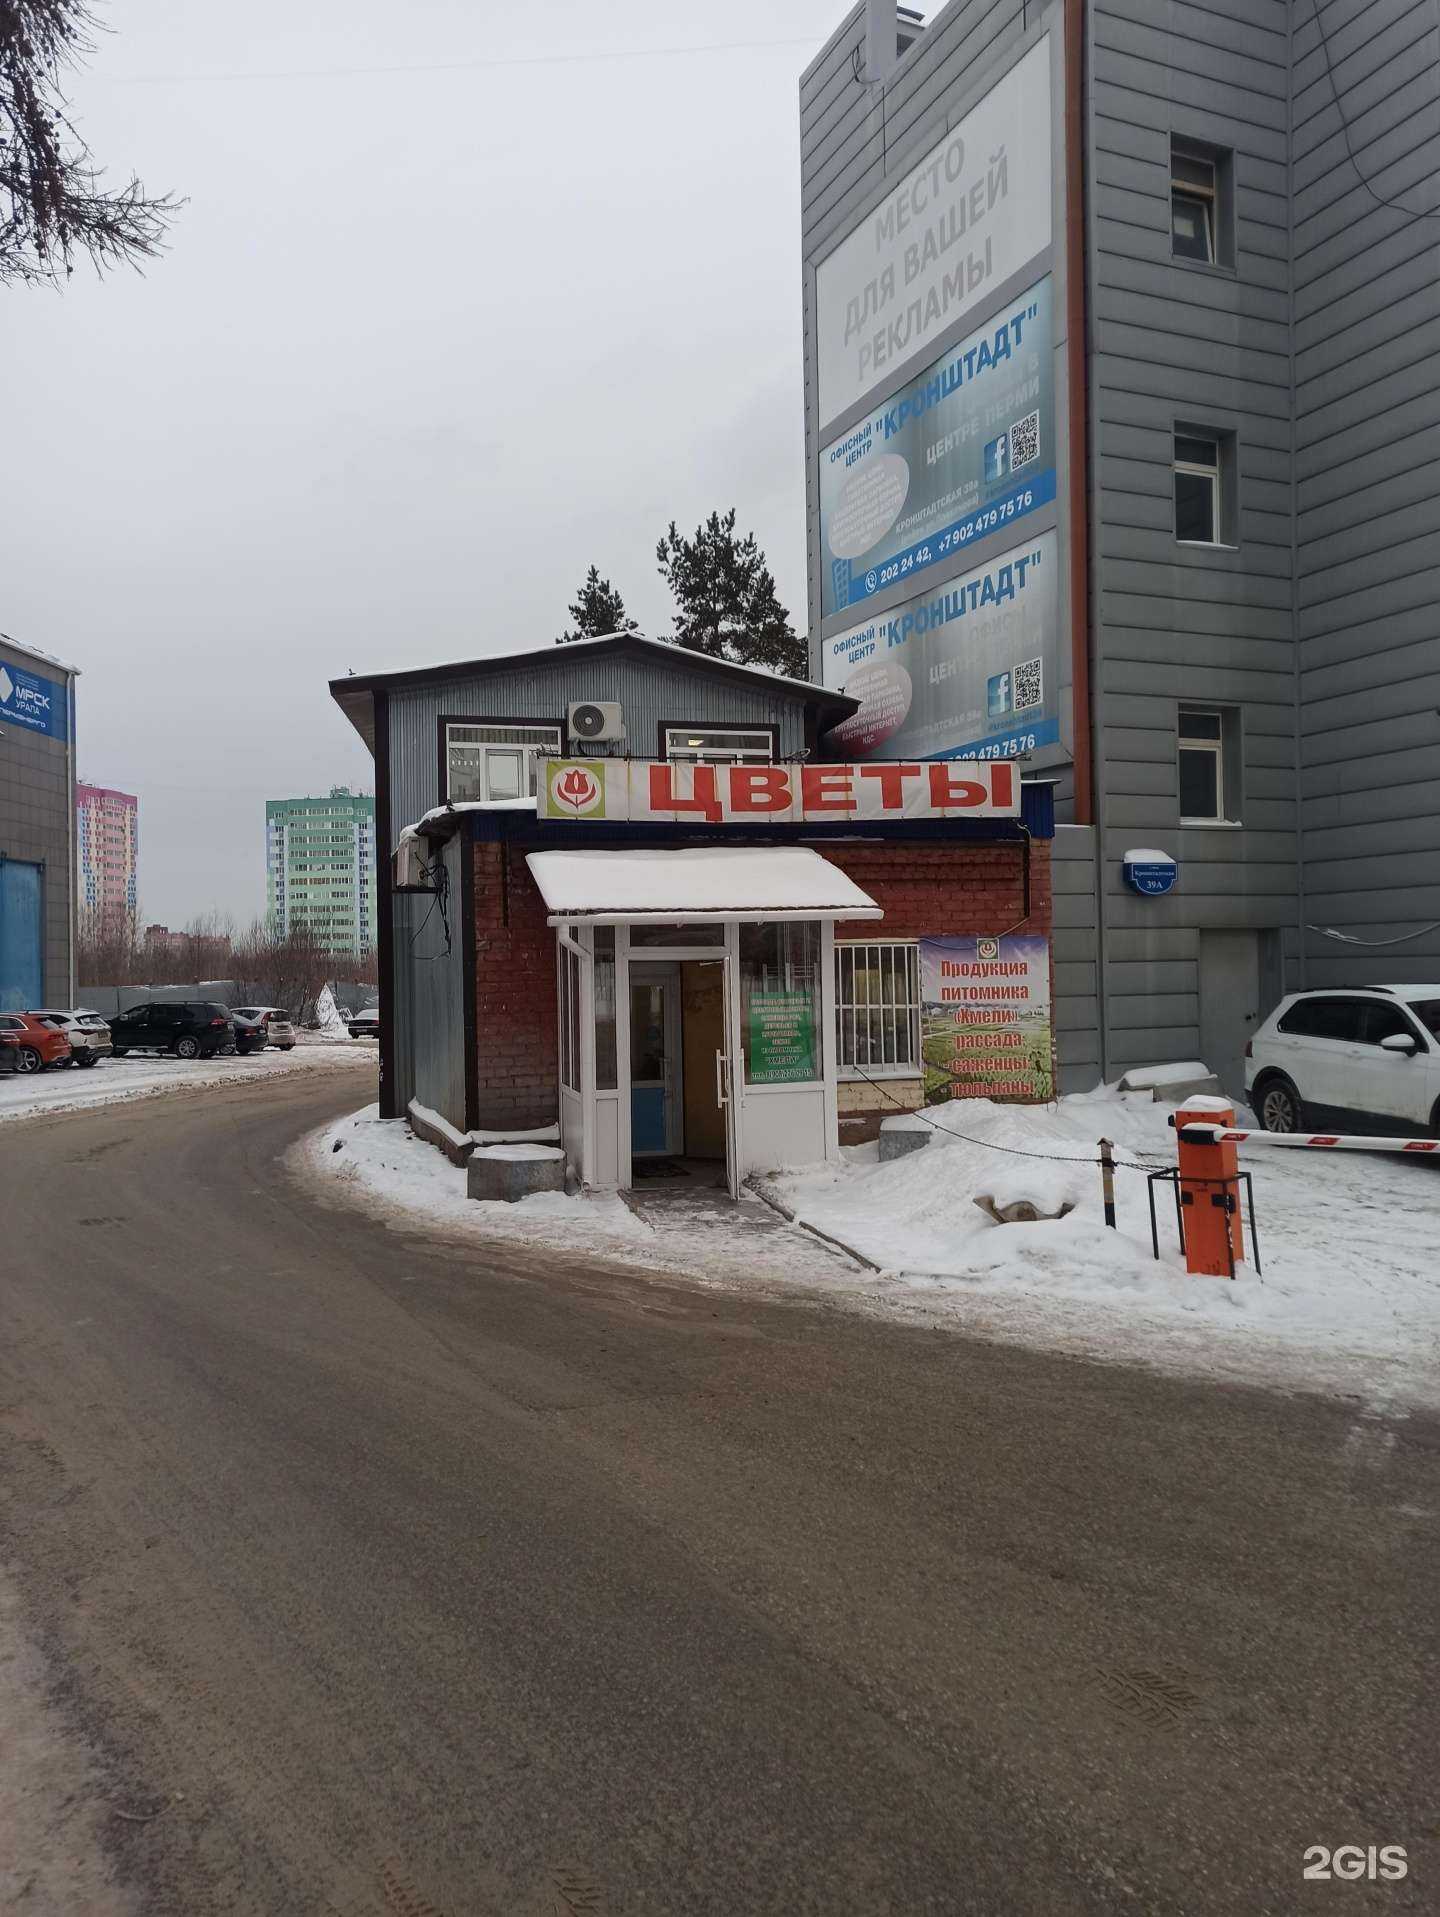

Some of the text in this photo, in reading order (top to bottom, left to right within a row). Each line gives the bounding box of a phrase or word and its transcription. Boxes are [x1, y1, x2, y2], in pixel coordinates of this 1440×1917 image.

[874, 137, 965, 253] МЕСТО
[844, 144, 1008, 347] ДЛЯ ВАШЕЙ
[857, 236, 993, 382] РЕКЛАМЫ
[830, 423, 872, 464] ОФИСНЫЙ
[845, 440, 872, 467] ЦЕНТР
[926, 416, 980, 465] ЦЕНТРЕ
[880, 566, 898, 584] 202
[900, 555, 914, 573] 24
[952, 523, 974, 544] 902
[975, 510, 998, 532] 479
[1000, 500, 1014, 520] 75
[1016, 491, 1032, 510] 76
[833, 628, 875, 656] ОФИСНЫЙ
[848, 643, 876, 664] ЦЕНТР
[16, 685, 50, 709] МРСК
[16, 699, 40, 715] УРАЛА
[978, 743, 1000, 759] 479
[1003, 739, 1017, 755] 75
[1019, 734, 1035, 750] 76
[649, 763, 1013, 822] ЦВЕТЫ
[941, 960, 1028, 979] Продукция
[941, 985, 1029, 1001] питомника
